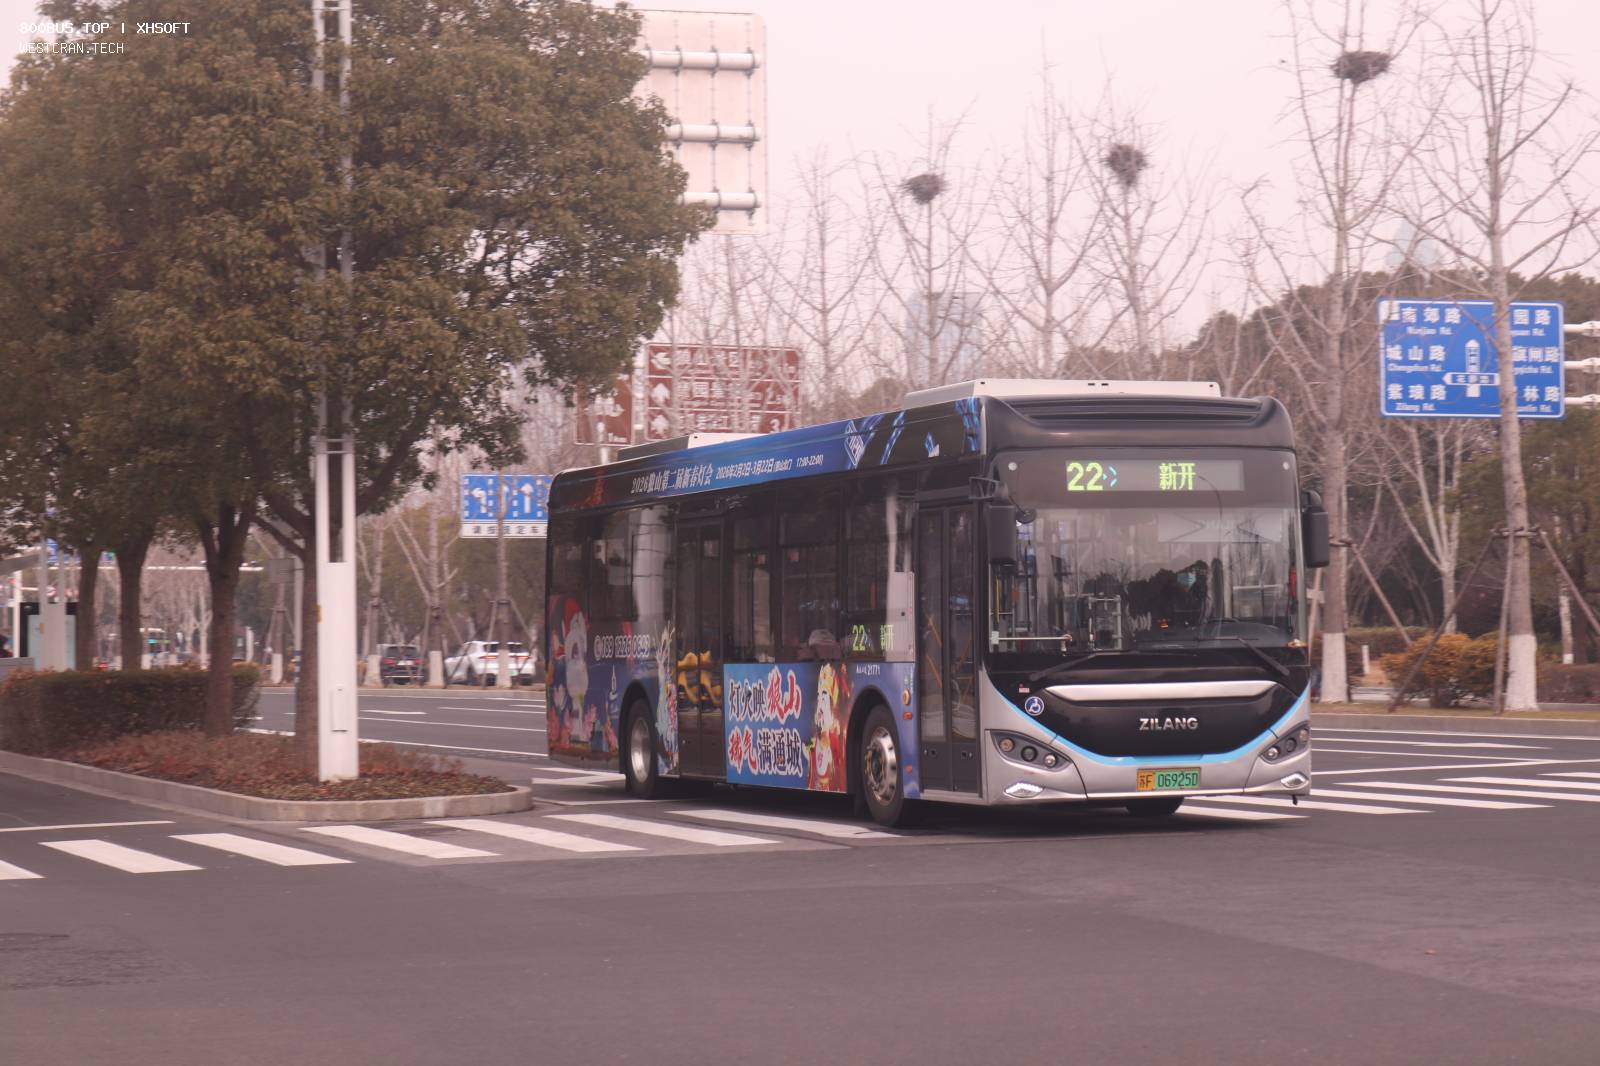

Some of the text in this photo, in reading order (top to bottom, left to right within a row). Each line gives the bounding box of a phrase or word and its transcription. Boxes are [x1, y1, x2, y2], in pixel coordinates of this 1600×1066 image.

[1066, 461, 1196, 491] 22 新开
[852, 624, 894, 651] 22 新开
[728, 665, 802, 725] 灯火映狼山
[1139, 716, 1199, 731] ZILANG
[728, 724, 803, 778] 瑞气满通城
